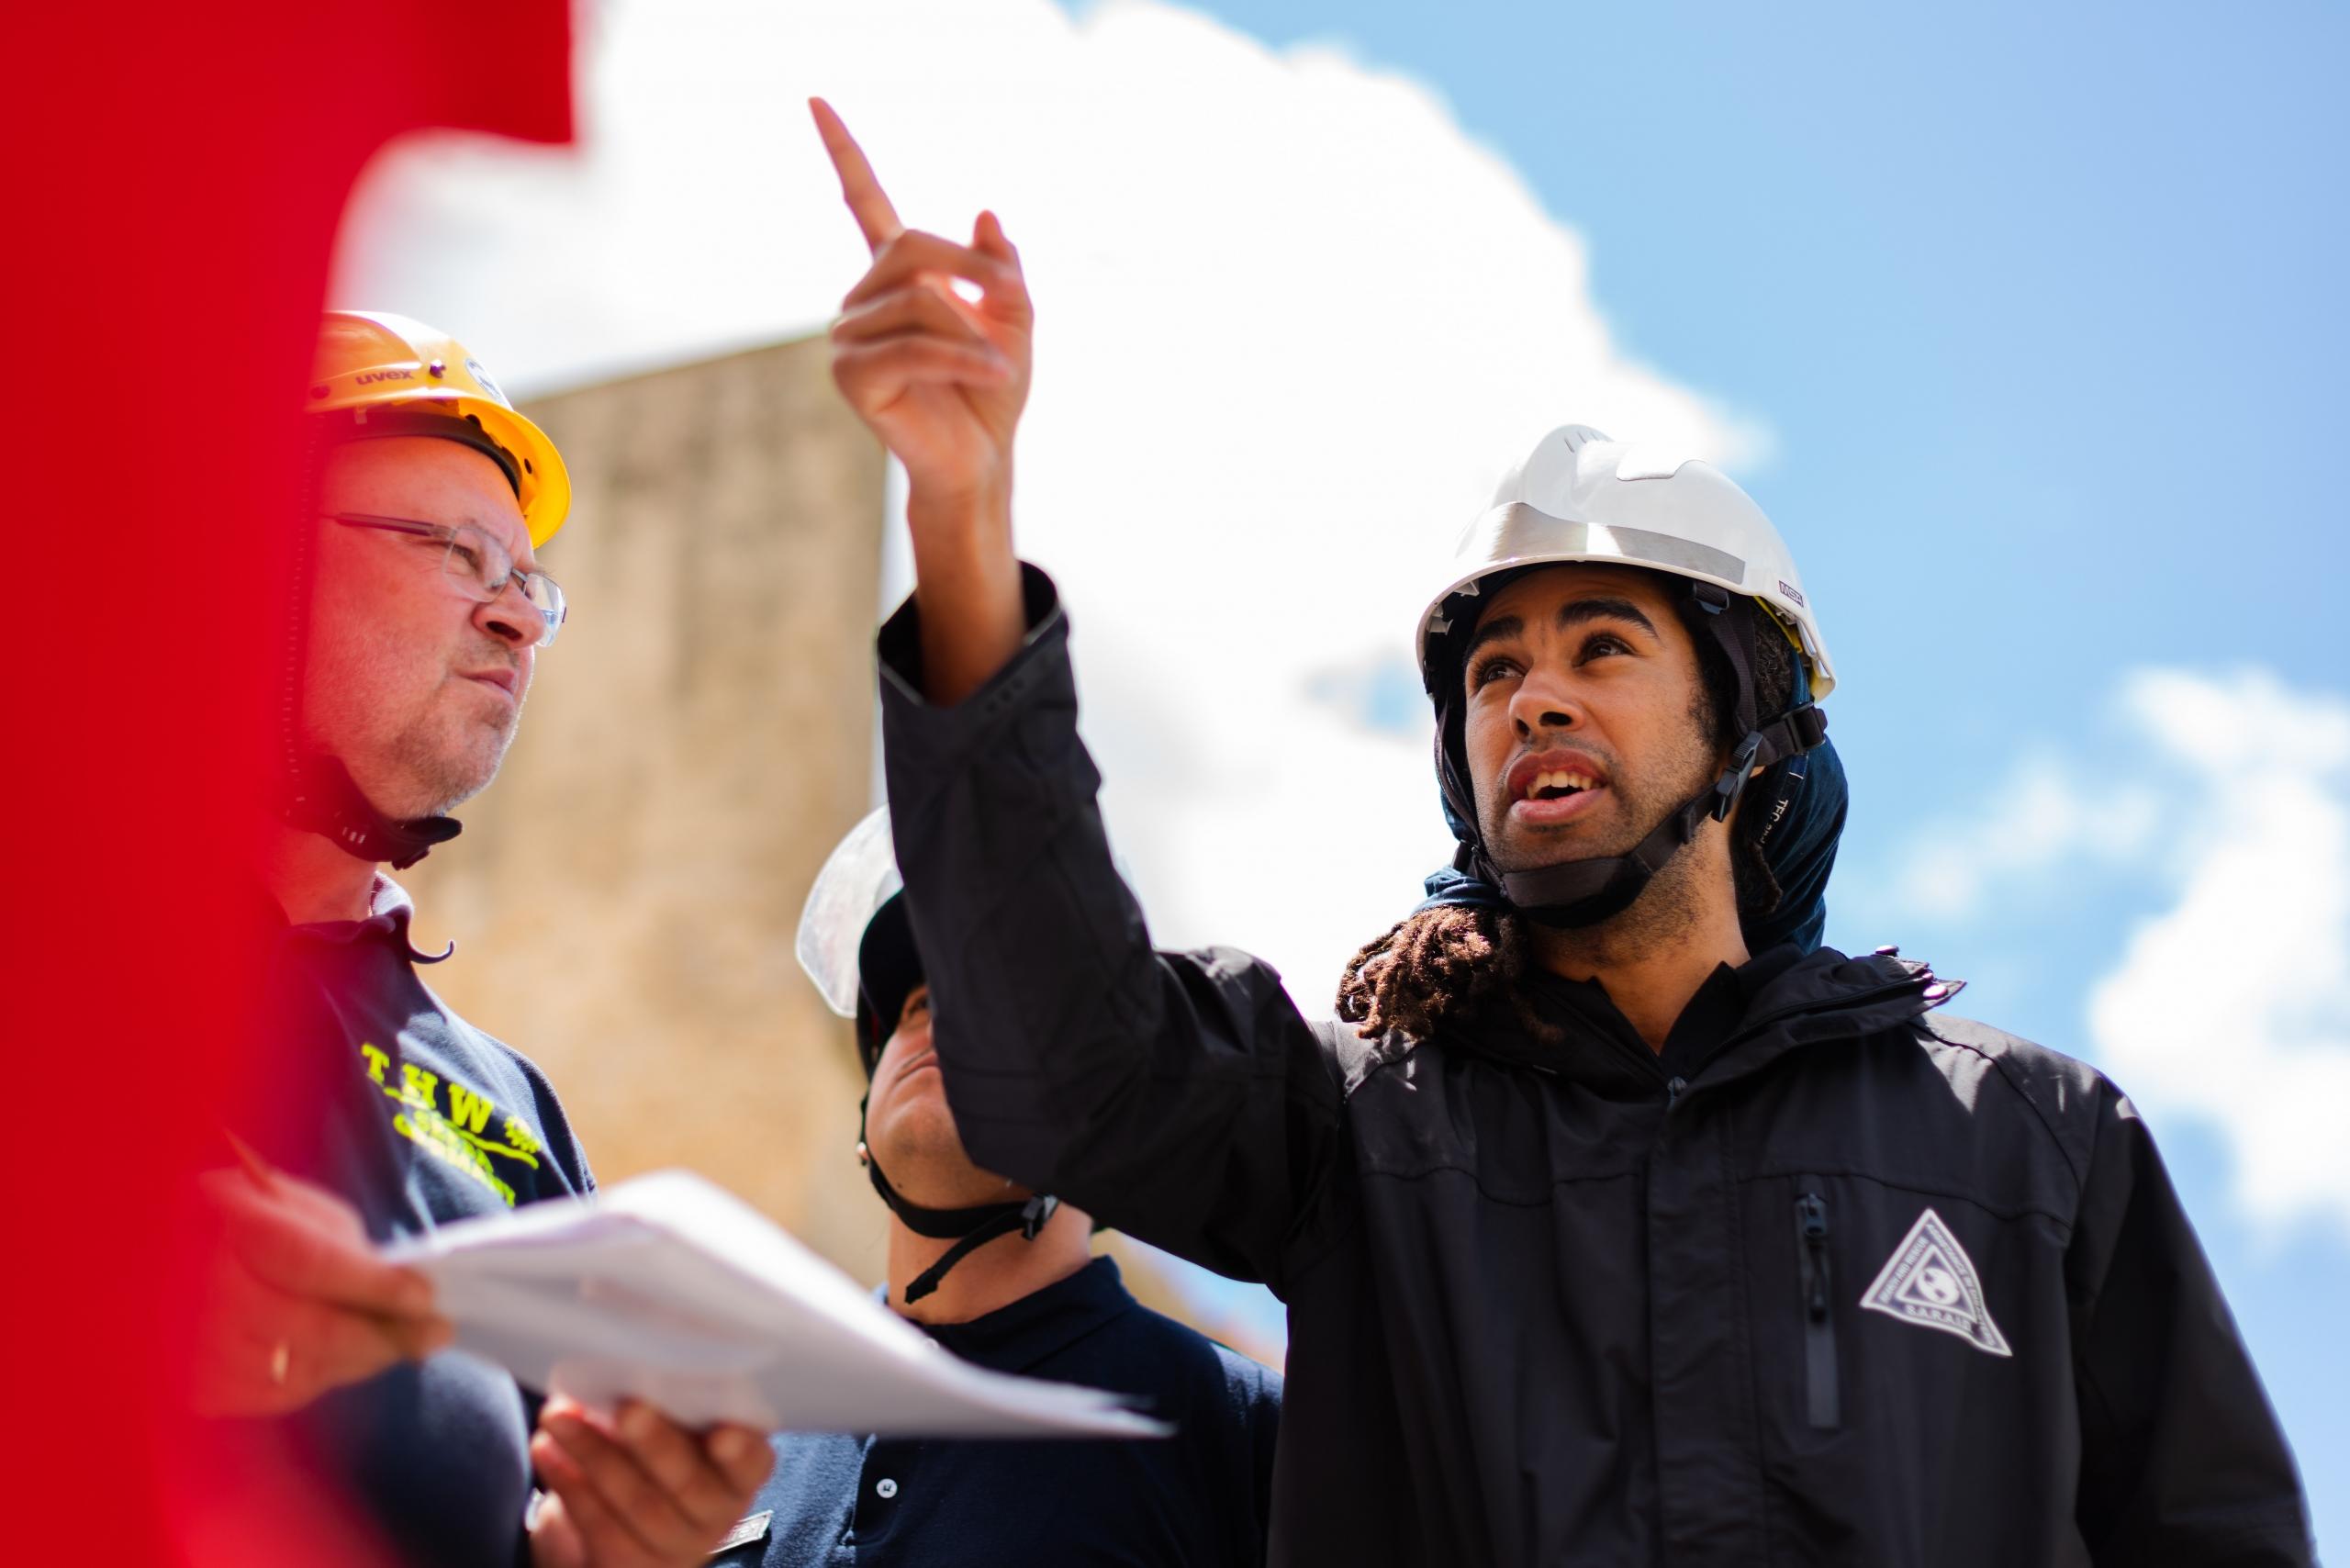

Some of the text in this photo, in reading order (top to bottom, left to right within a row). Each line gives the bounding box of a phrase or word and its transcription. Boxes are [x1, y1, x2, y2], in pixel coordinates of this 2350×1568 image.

[355, 368, 415, 386] uvex
[1779, 581, 1804, 607] MSA
[361, 1042, 495, 1134] THW
[1905, 1305, 1974, 1331] SARAID
